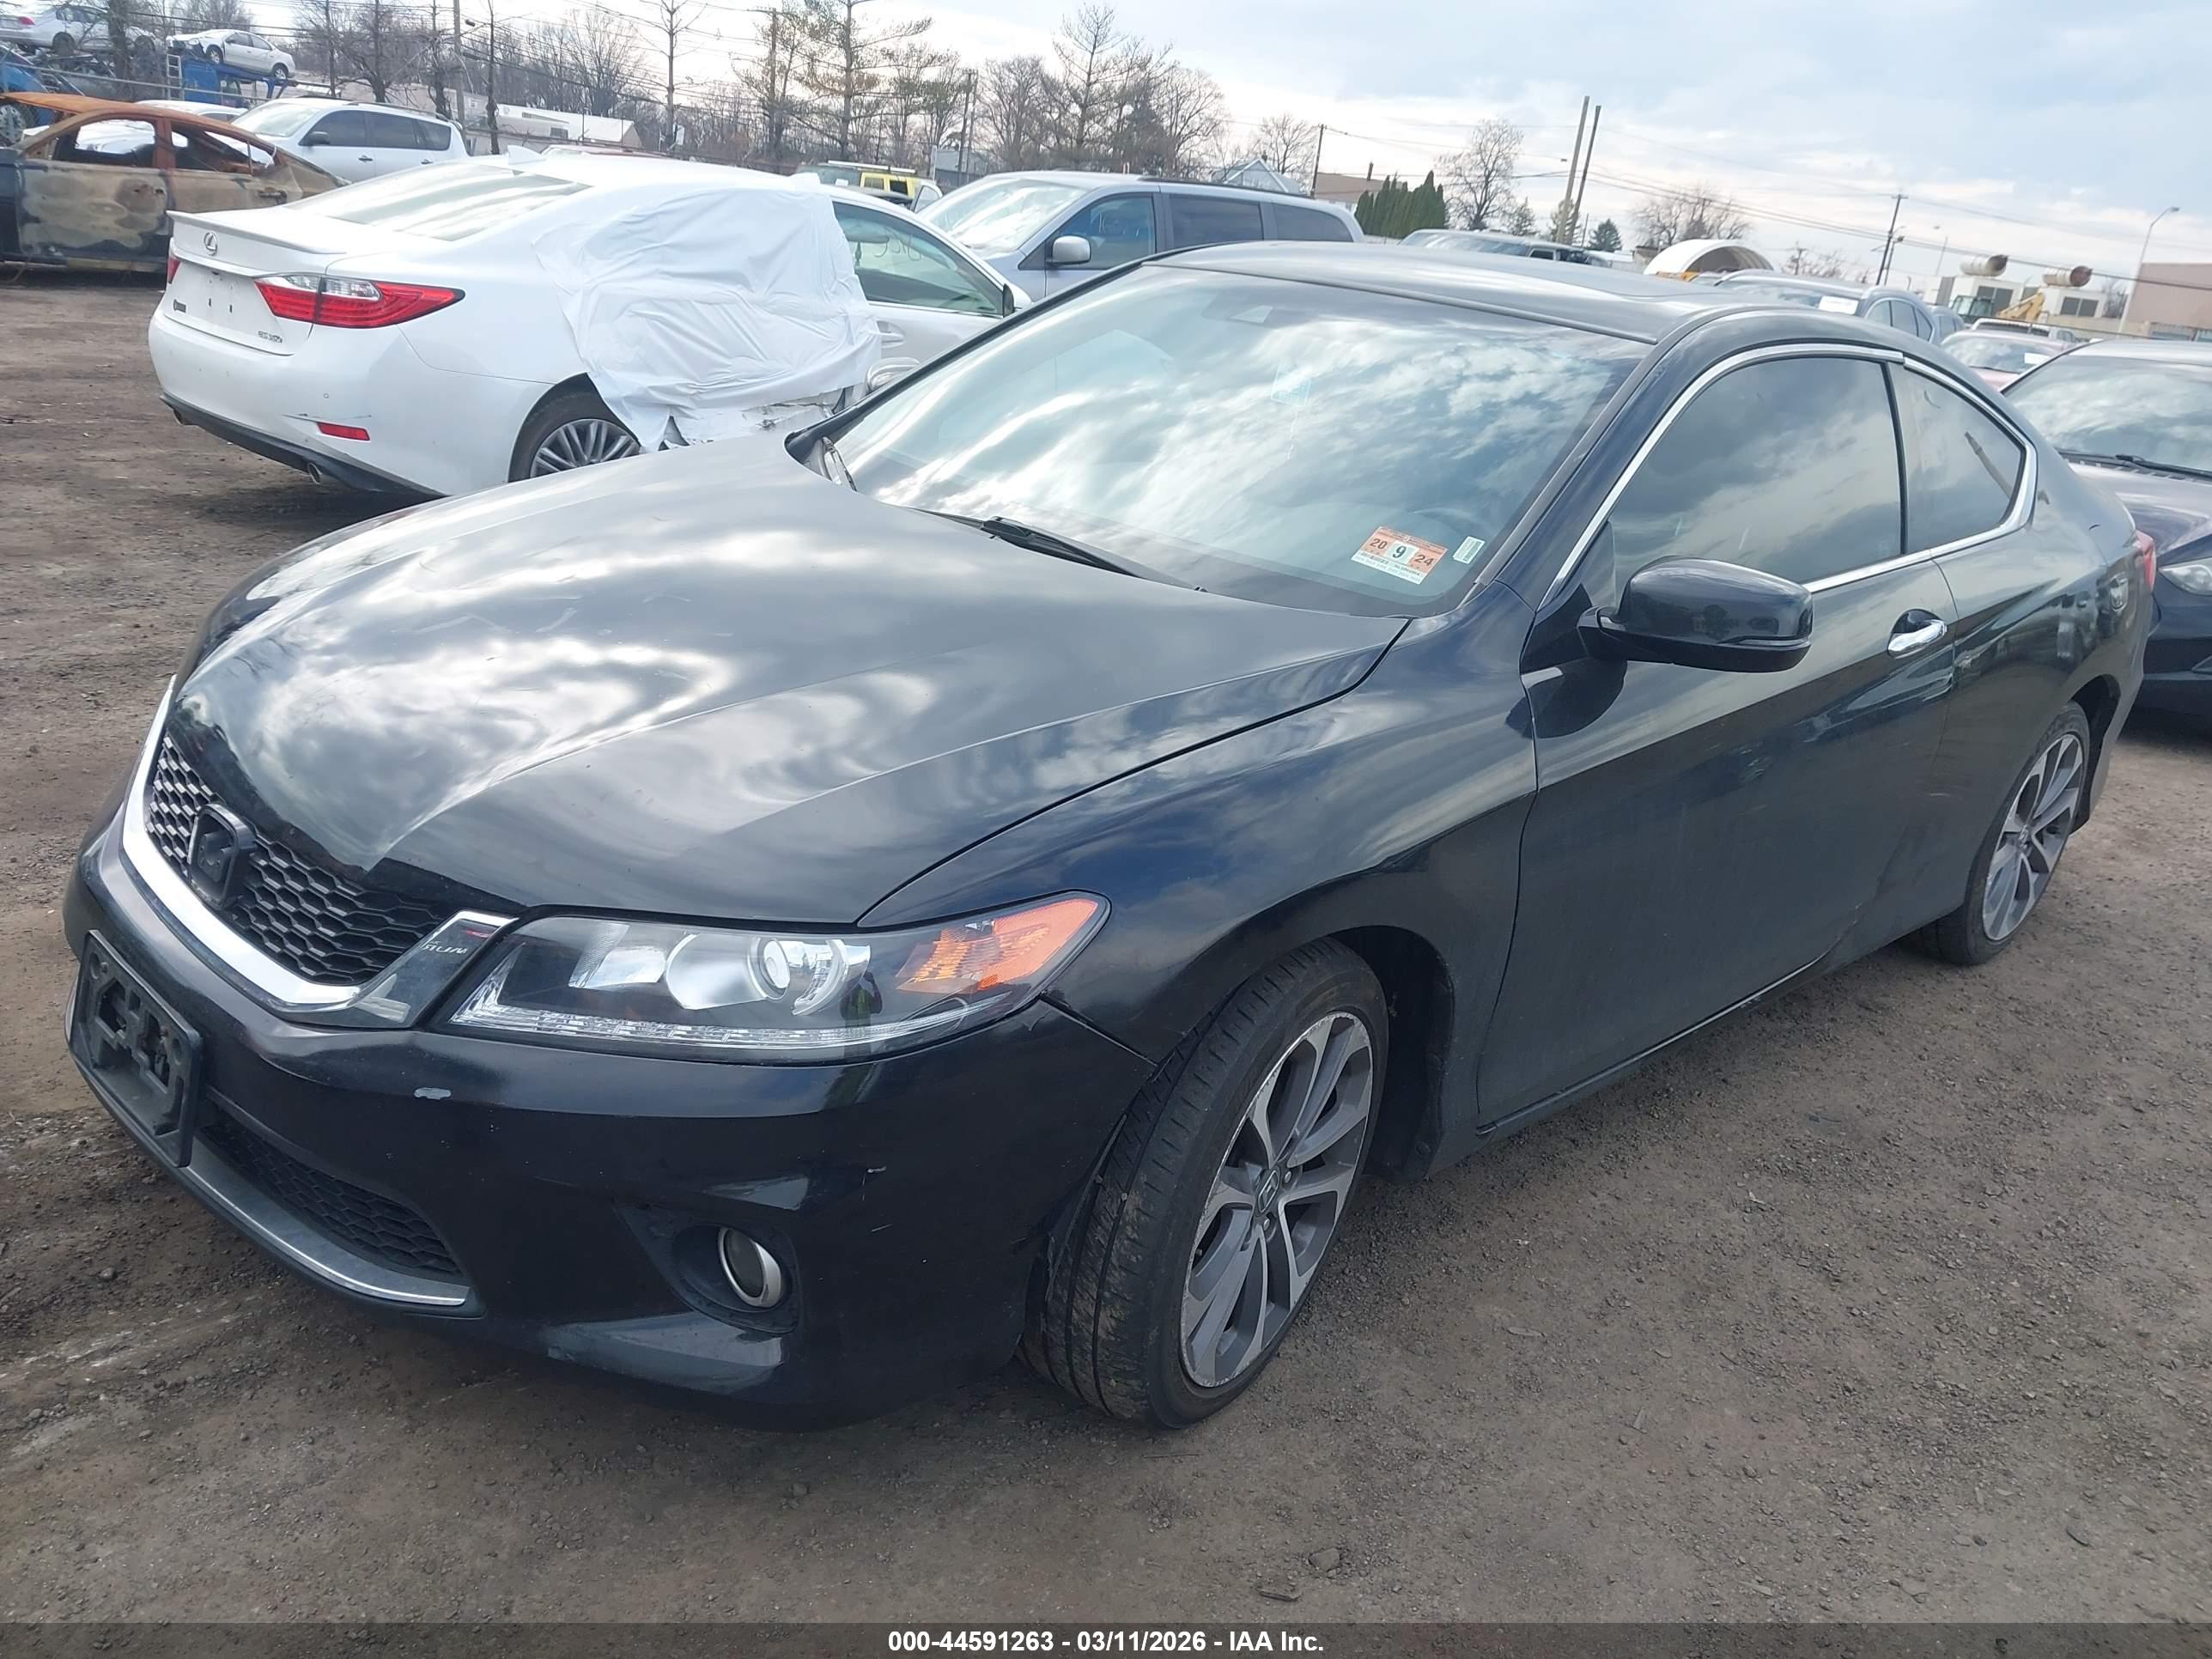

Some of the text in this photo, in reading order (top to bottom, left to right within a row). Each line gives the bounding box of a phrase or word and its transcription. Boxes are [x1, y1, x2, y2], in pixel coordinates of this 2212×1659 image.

[1370, 538, 1434, 566] 20 9 24
